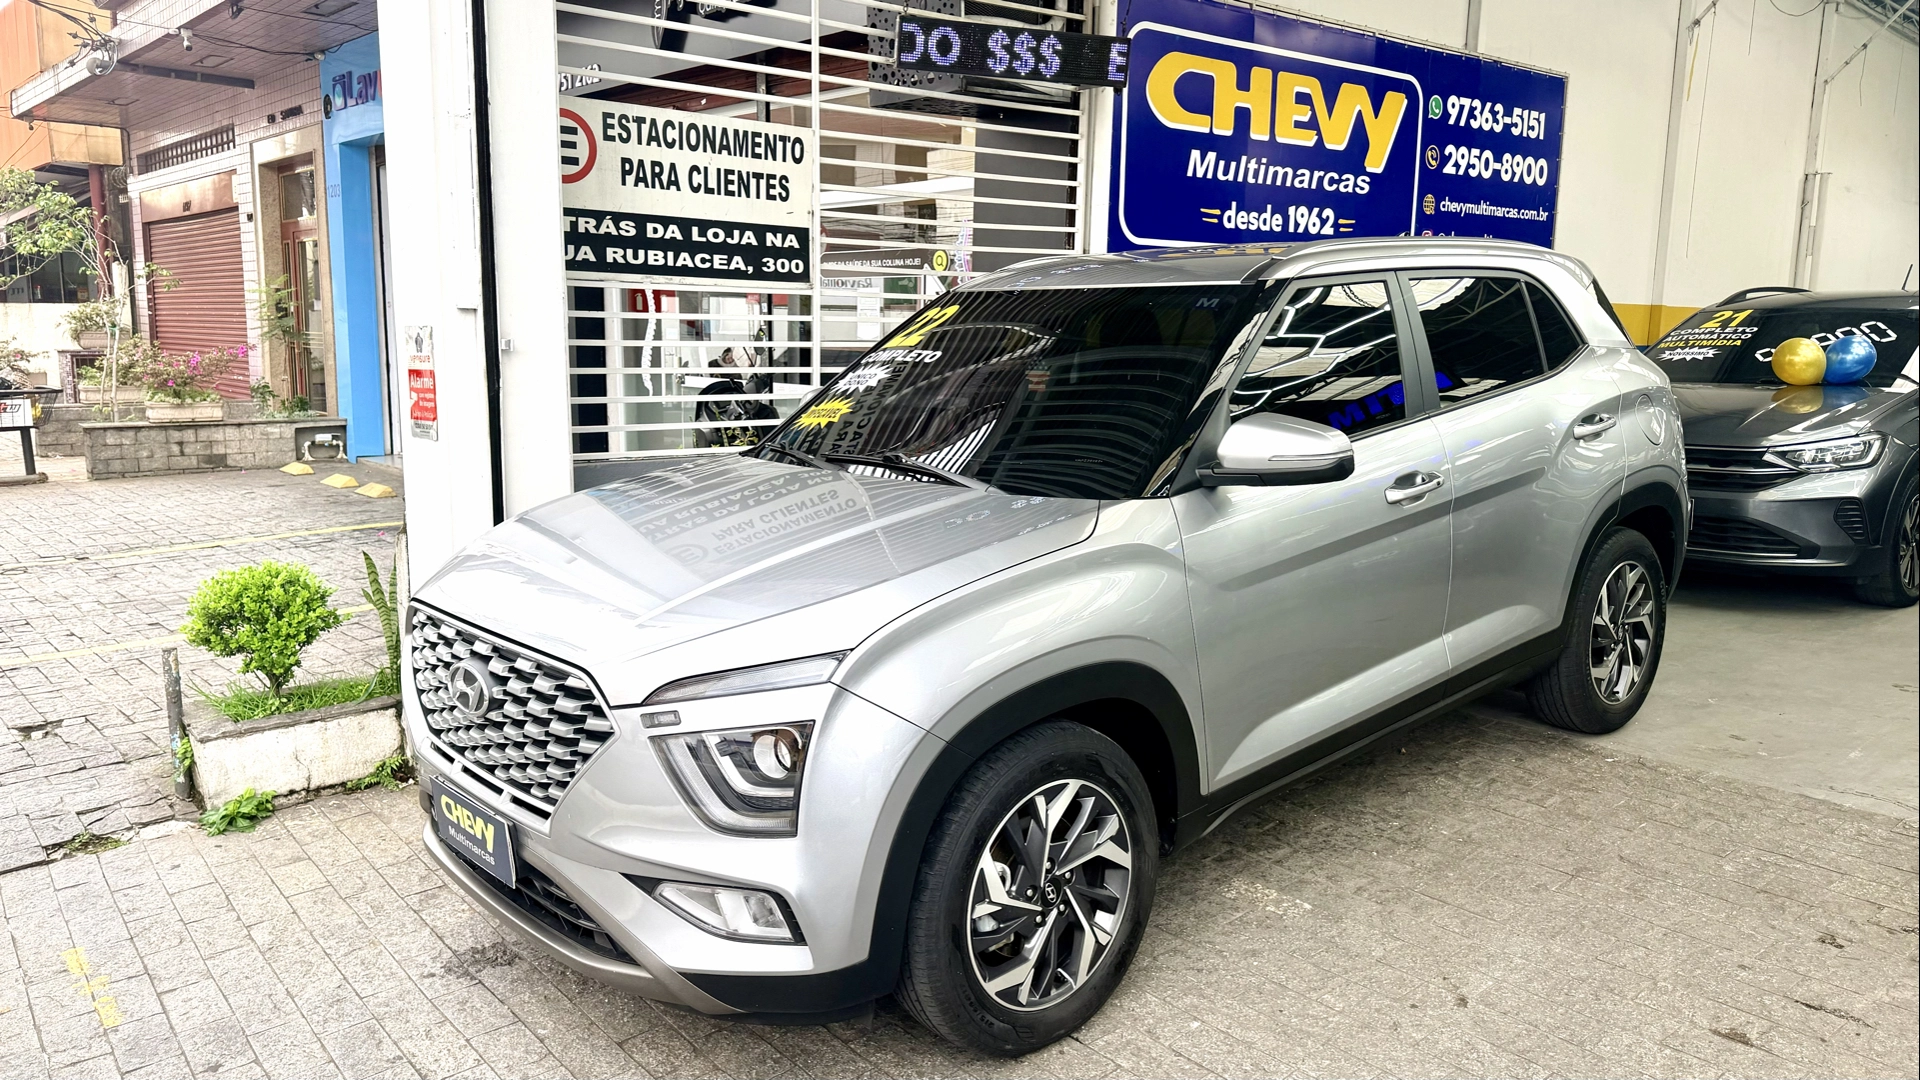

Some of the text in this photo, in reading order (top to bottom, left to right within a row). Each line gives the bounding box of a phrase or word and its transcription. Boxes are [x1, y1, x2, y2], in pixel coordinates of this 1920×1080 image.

[987, 29, 1062, 78] $$$
[1146, 51, 1408, 174] CHEVY
[1447, 95, 1546, 140] 97363-5151
[601, 110, 805, 165] ESTACIONAMENTO
[620, 156, 790, 202] PARA CLIENTES
[1186, 149, 1371, 195] Multimarcas
[1442, 144, 1548, 186] 2950-8900
[1222, 201, 1335, 235] desde 1962
[1440, 196, 1549, 221] chevymultimarcas.com.br
[563, 216, 800, 249] TRÁS DA LOJA NA
[606, 247, 754, 274] RUBIACEA,
[761, 257, 804, 274] 300
[881, 305, 961, 349] 22
[1662, 332, 1753, 342] AUTOMÁTICO
[1669, 327, 1759, 336] COMPLETO
[1699, 309, 1754, 328] 21
[860, 350, 943, 363] COMPLETO
[1656, 338, 1743, 349] MULTIMÍDIA
[410, 374, 434, 389] Alarme
[441, 794, 495, 853] CHEVY
[448, 825, 496, 866] Multimarcas
